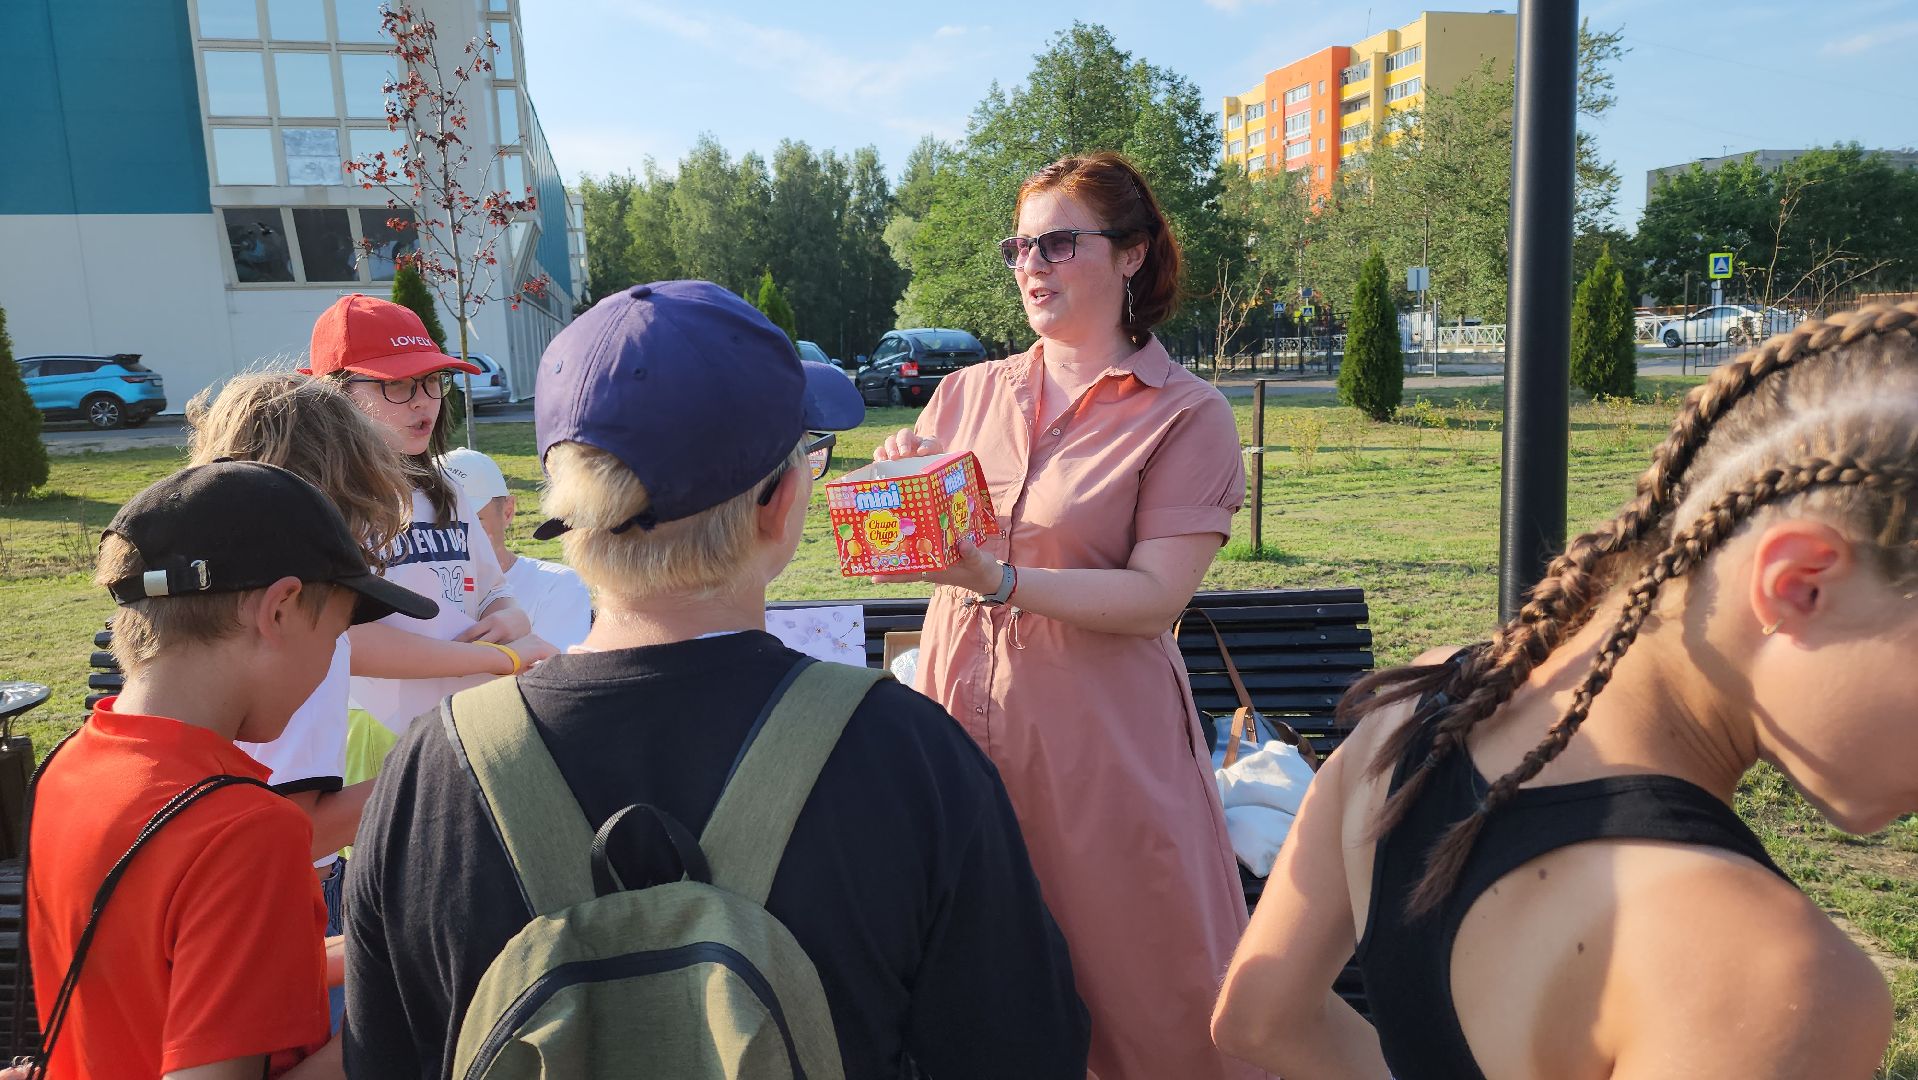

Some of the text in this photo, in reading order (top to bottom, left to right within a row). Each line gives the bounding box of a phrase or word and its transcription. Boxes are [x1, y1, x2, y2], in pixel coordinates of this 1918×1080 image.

[390, 335, 433, 347] LOVELY
[445, 466, 468, 480] ONIC
[855, 483, 900, 511] mini
[868, 519, 898, 532] Chupa
[869, 529, 898, 545] Chups
